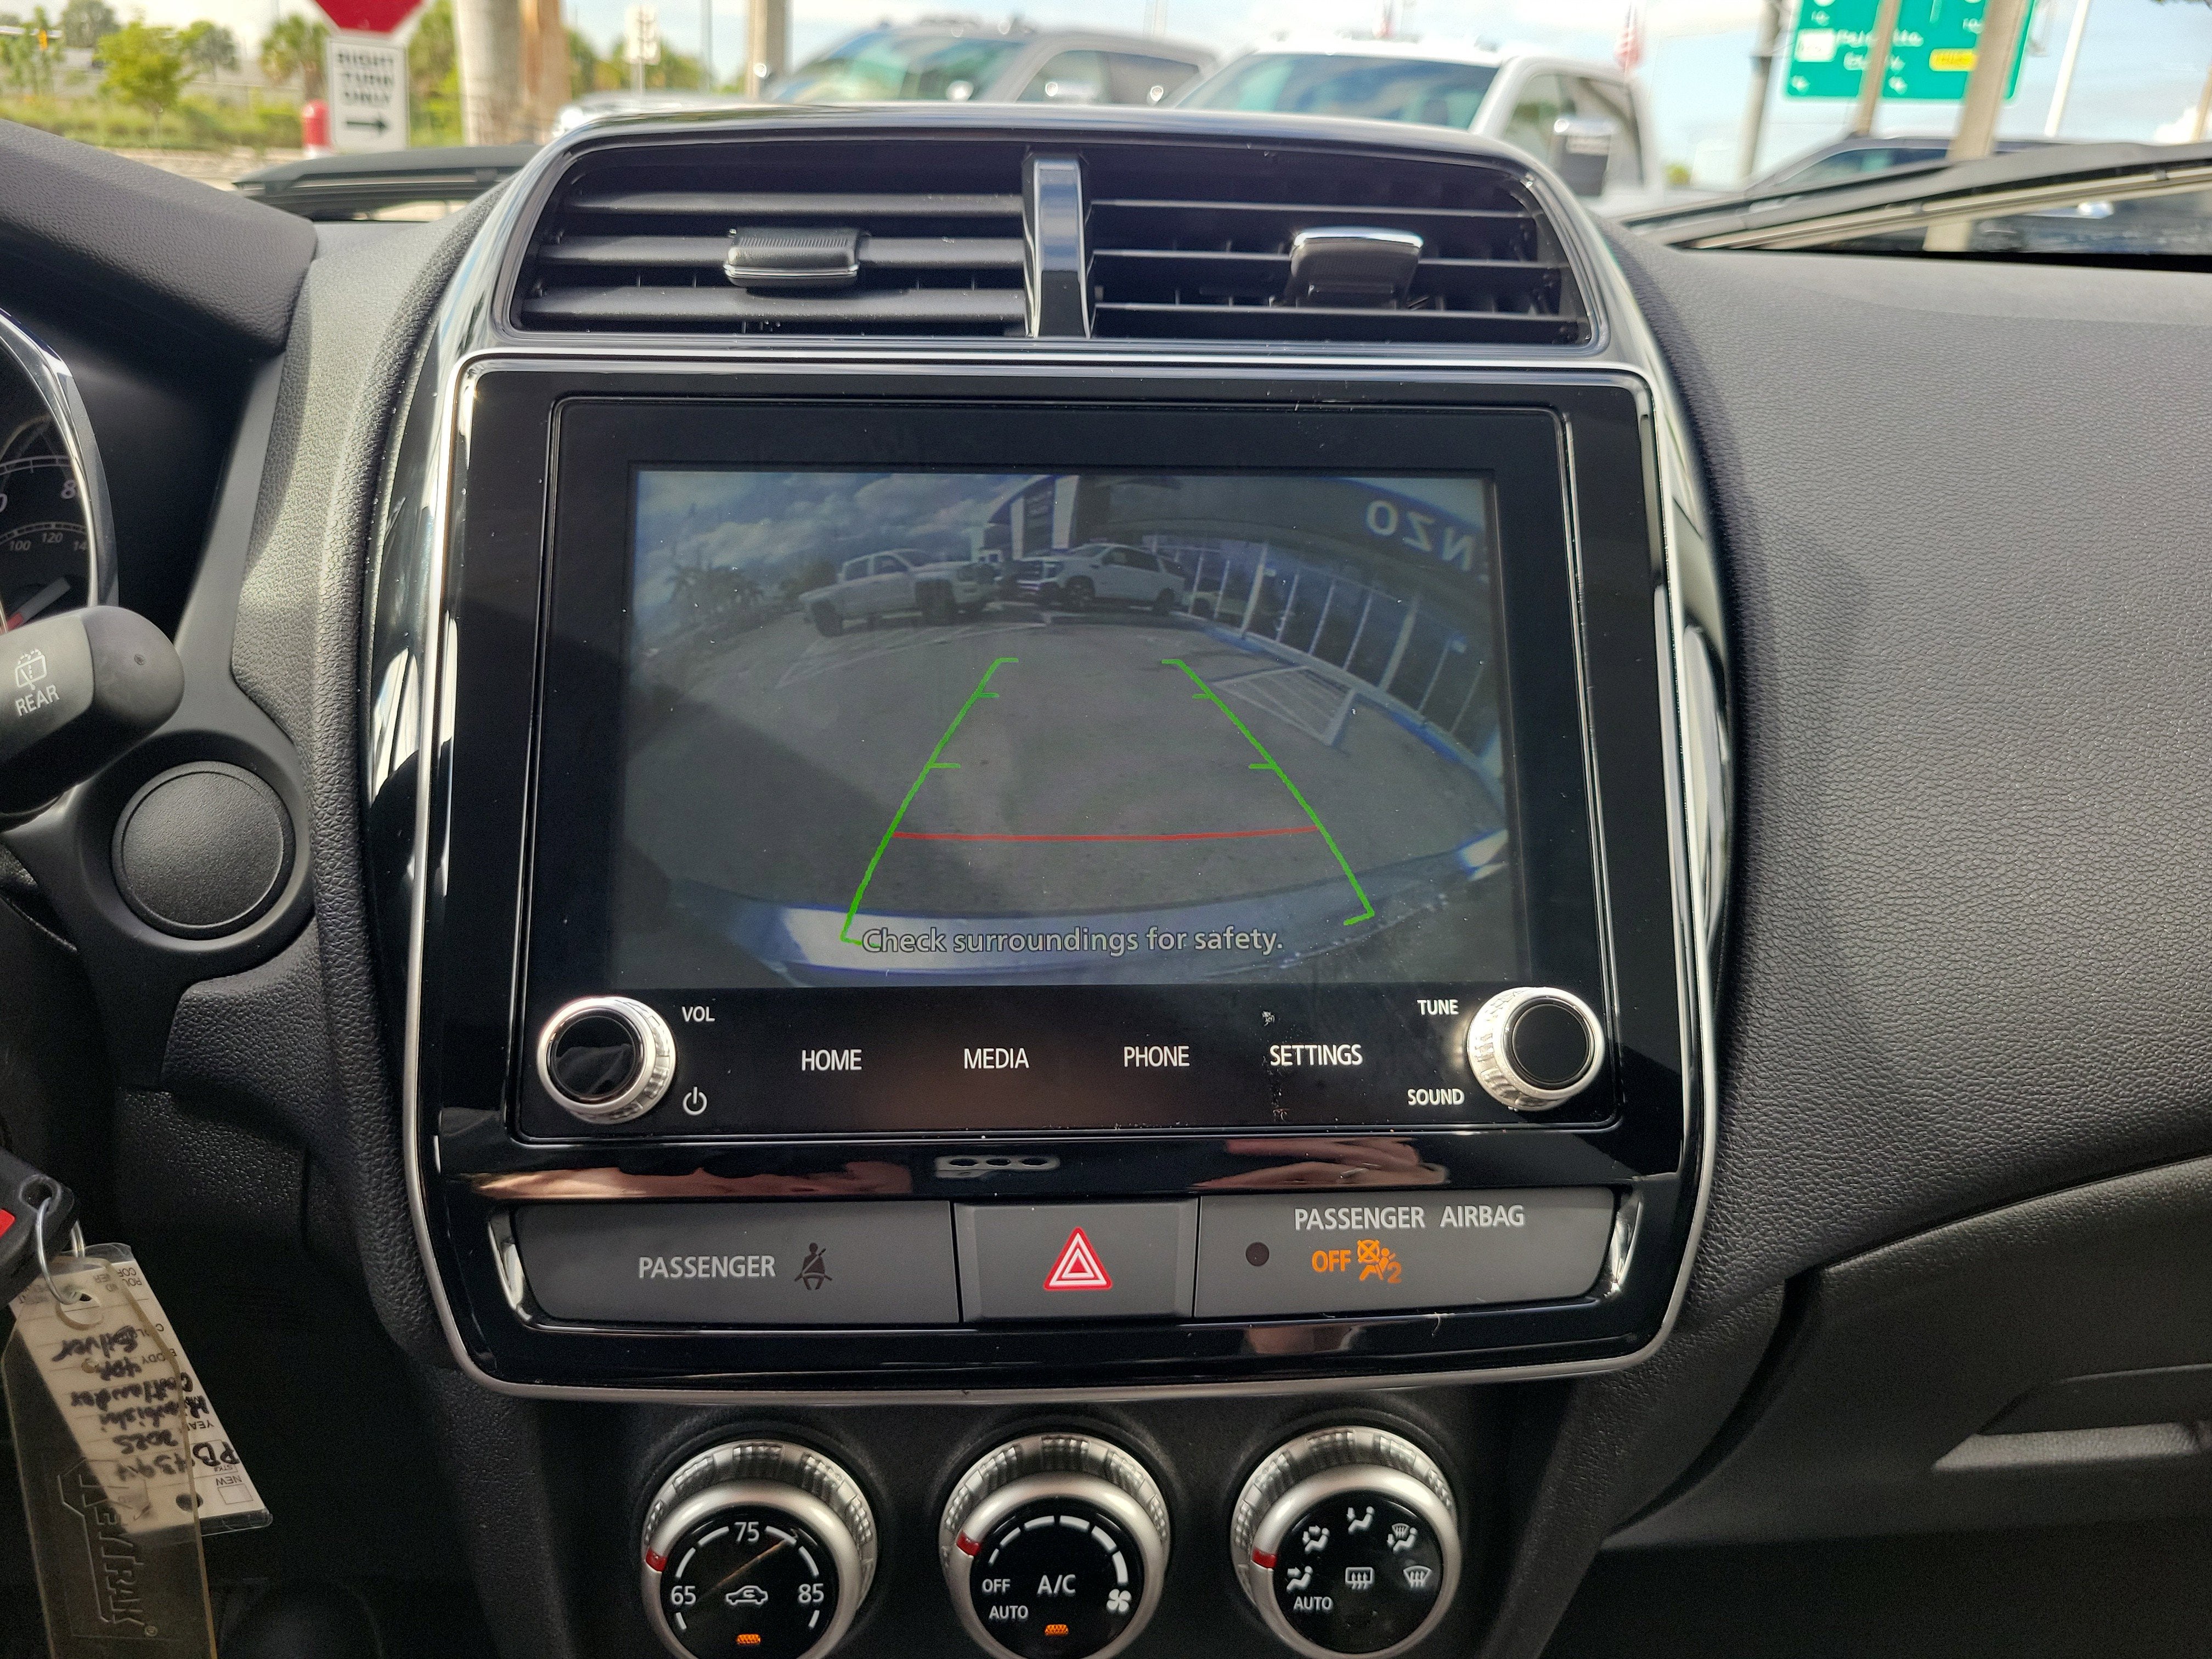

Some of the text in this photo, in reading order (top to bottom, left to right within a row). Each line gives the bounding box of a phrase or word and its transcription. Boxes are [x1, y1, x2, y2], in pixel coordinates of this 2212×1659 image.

[10, 540, 31, 551] 100
[42, 532, 64, 543] 120
[15, 685, 60, 716] REAR
[862, 926, 1284, 957] Check surroundings for safety.
[682, 1006, 715, 1023] VOL
[1417, 999, 1459, 1015] TUNE
[801, 1049, 863, 1071] HOME
[963, 1047, 1029, 1070] MEDIA
[1124, 1045, 1190, 1068] PHONE
[1269, 1043, 1364, 1066] SETTINGS
[1407, 1088, 1465, 1106] SOUND
[1295, 1205, 1525, 1231] PASSENGER AIRBAG
[639, 1255, 776, 1279] PASSENGER
[1312, 1250, 1351, 1273] OFF
[216, 1475, 242, 1486] NEW
[734, 1521, 760, 1543] 75
[671, 1585, 697, 1605] 65
[798, 1583, 824, 1604] 85
[982, 1578, 1011, 1594] OFF
[1037, 1574, 1076, 1596] A/C
[989, 1605, 1029, 1620] AUTO
[1294, 1596, 1333, 1611] AUTO
